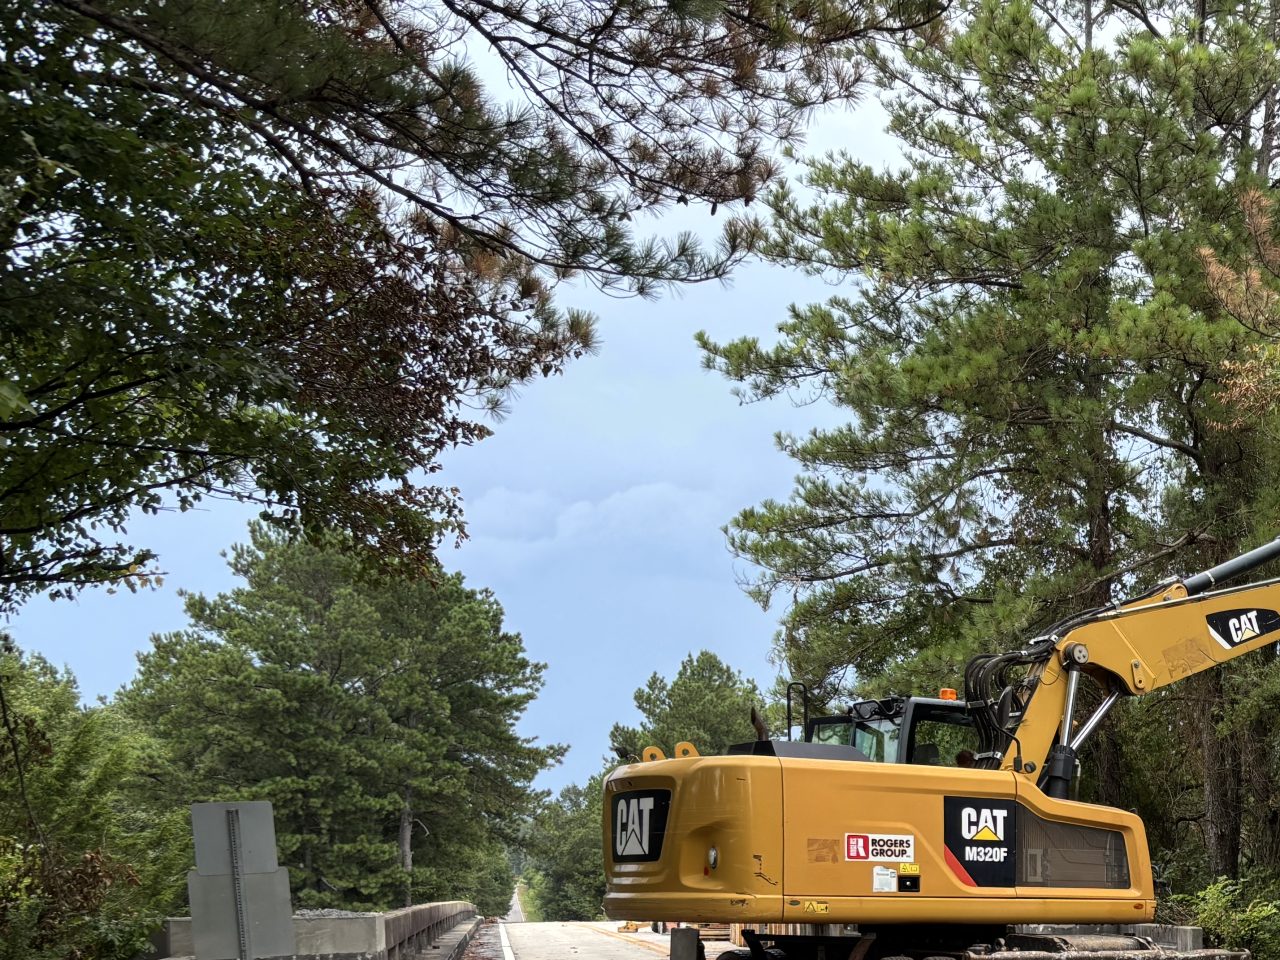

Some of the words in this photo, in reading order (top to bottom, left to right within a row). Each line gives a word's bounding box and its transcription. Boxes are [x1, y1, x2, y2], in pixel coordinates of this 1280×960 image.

[1229, 611, 1260, 643] CAT
[616, 797, 654, 855] CAT
[961, 807, 1008, 841] CAT
[871, 838, 911, 848] ROGERS
[871, 848, 907, 858] GROUP
[965, 846, 1008, 862] M320F
